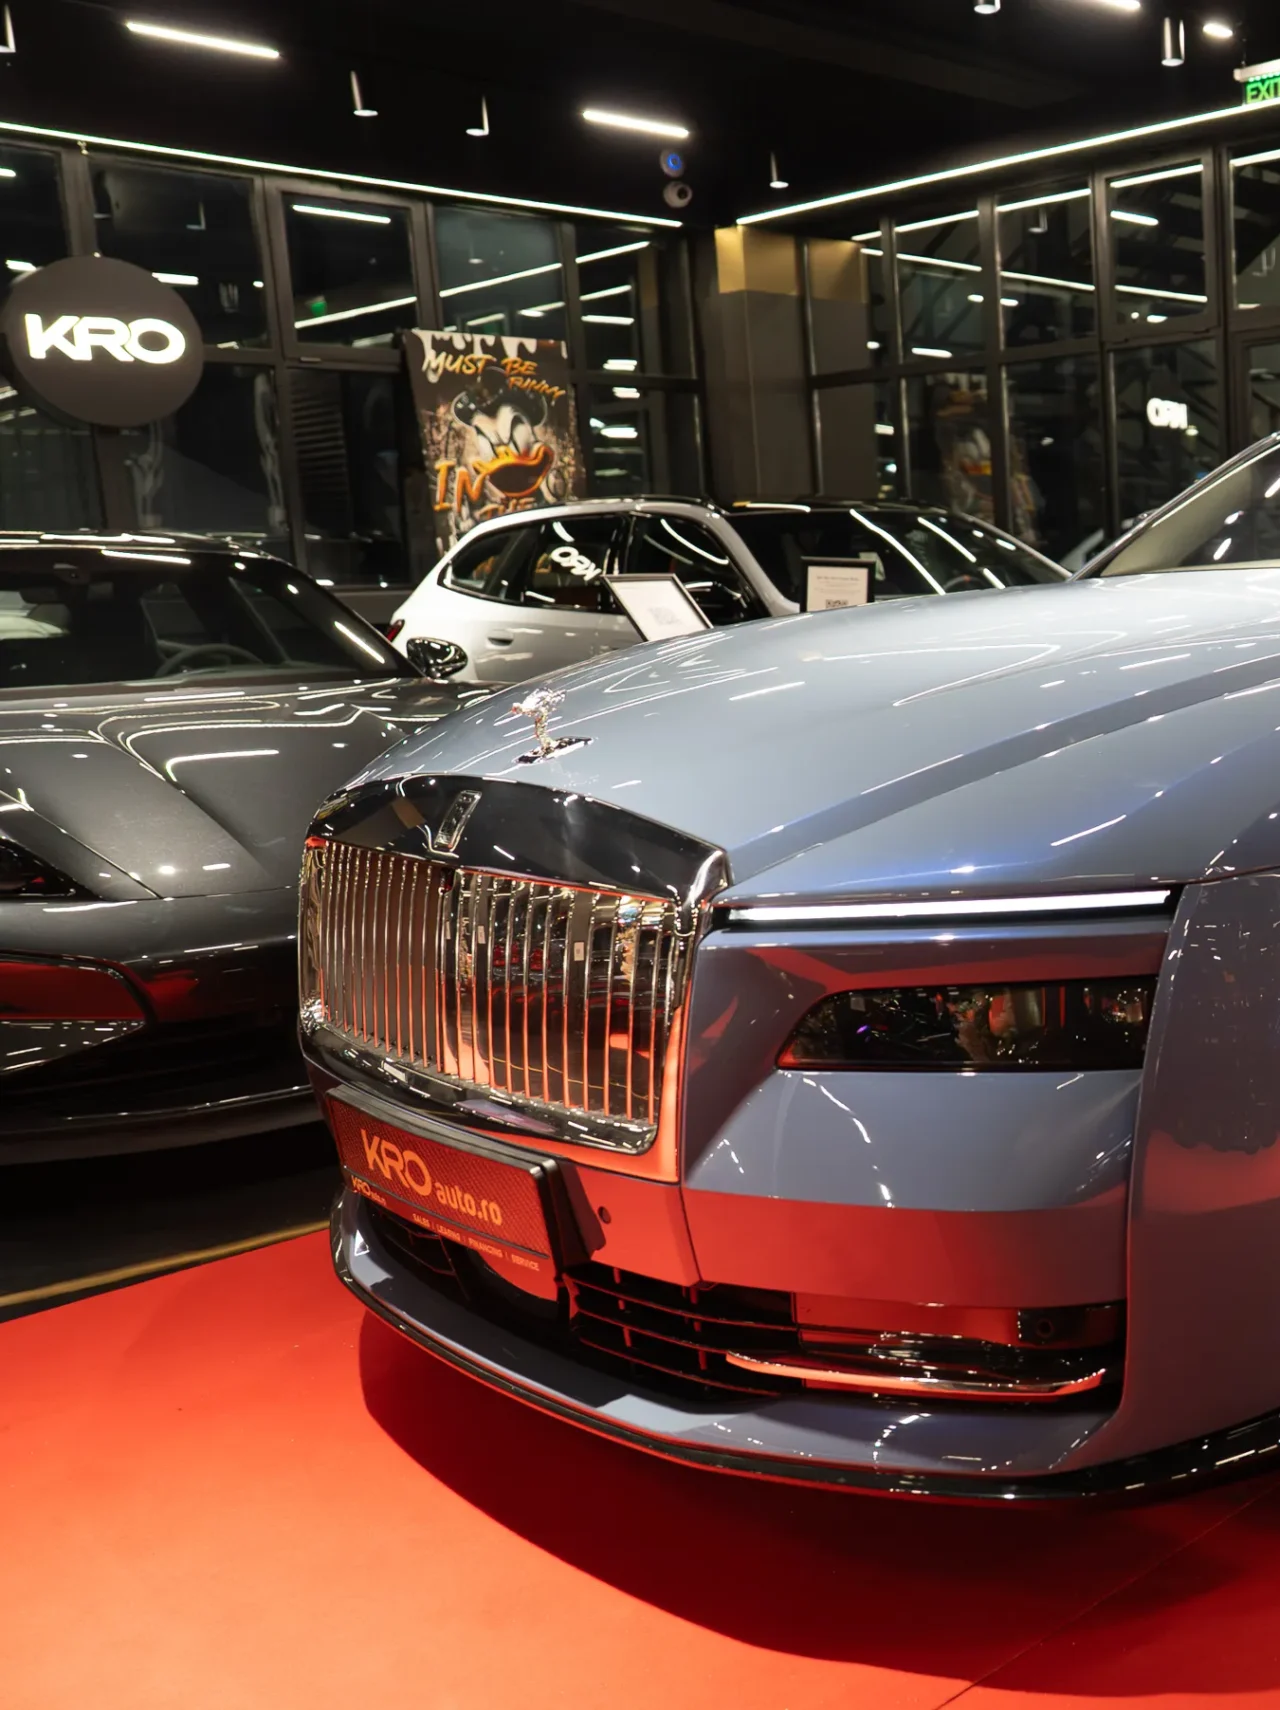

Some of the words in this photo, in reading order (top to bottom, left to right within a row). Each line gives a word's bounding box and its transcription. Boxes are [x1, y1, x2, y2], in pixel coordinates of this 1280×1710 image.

[24, 313, 186, 364] KRO
[422, 350, 497, 379] MUST
[501, 357, 538, 377] BE
[434, 460, 488, 513] IN
[361, 1129, 432, 1196] KRO
